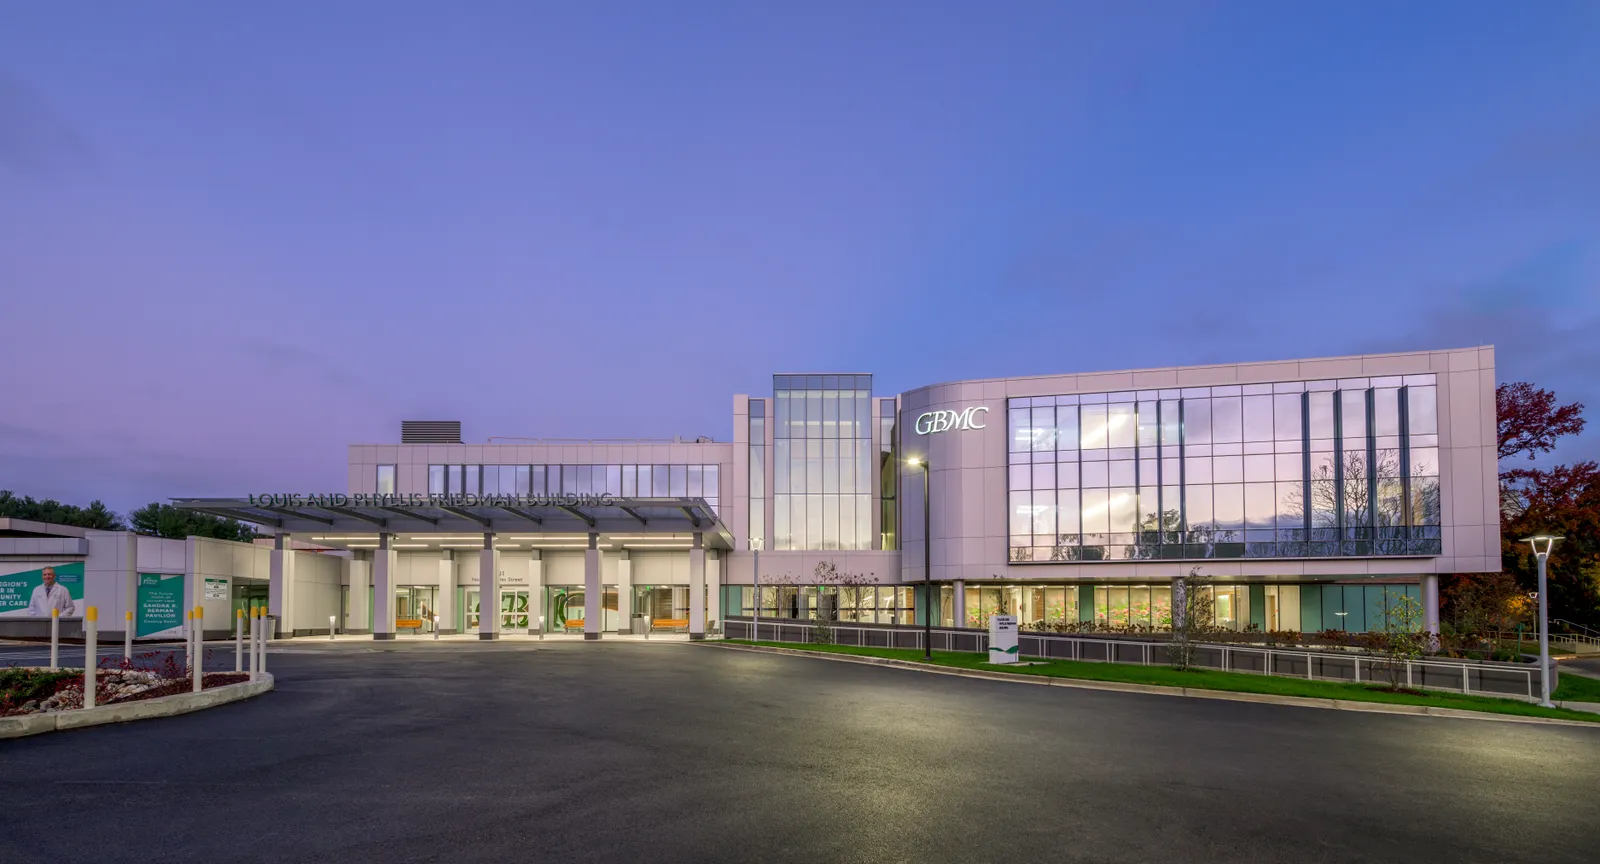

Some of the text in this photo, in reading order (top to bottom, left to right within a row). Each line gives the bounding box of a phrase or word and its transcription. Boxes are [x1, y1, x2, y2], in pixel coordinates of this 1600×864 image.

[915, 406, 989, 435] GBMC
[249, 493, 613, 508] LOUIS AND PHYLLIS FRIEDMAN BUILDING
